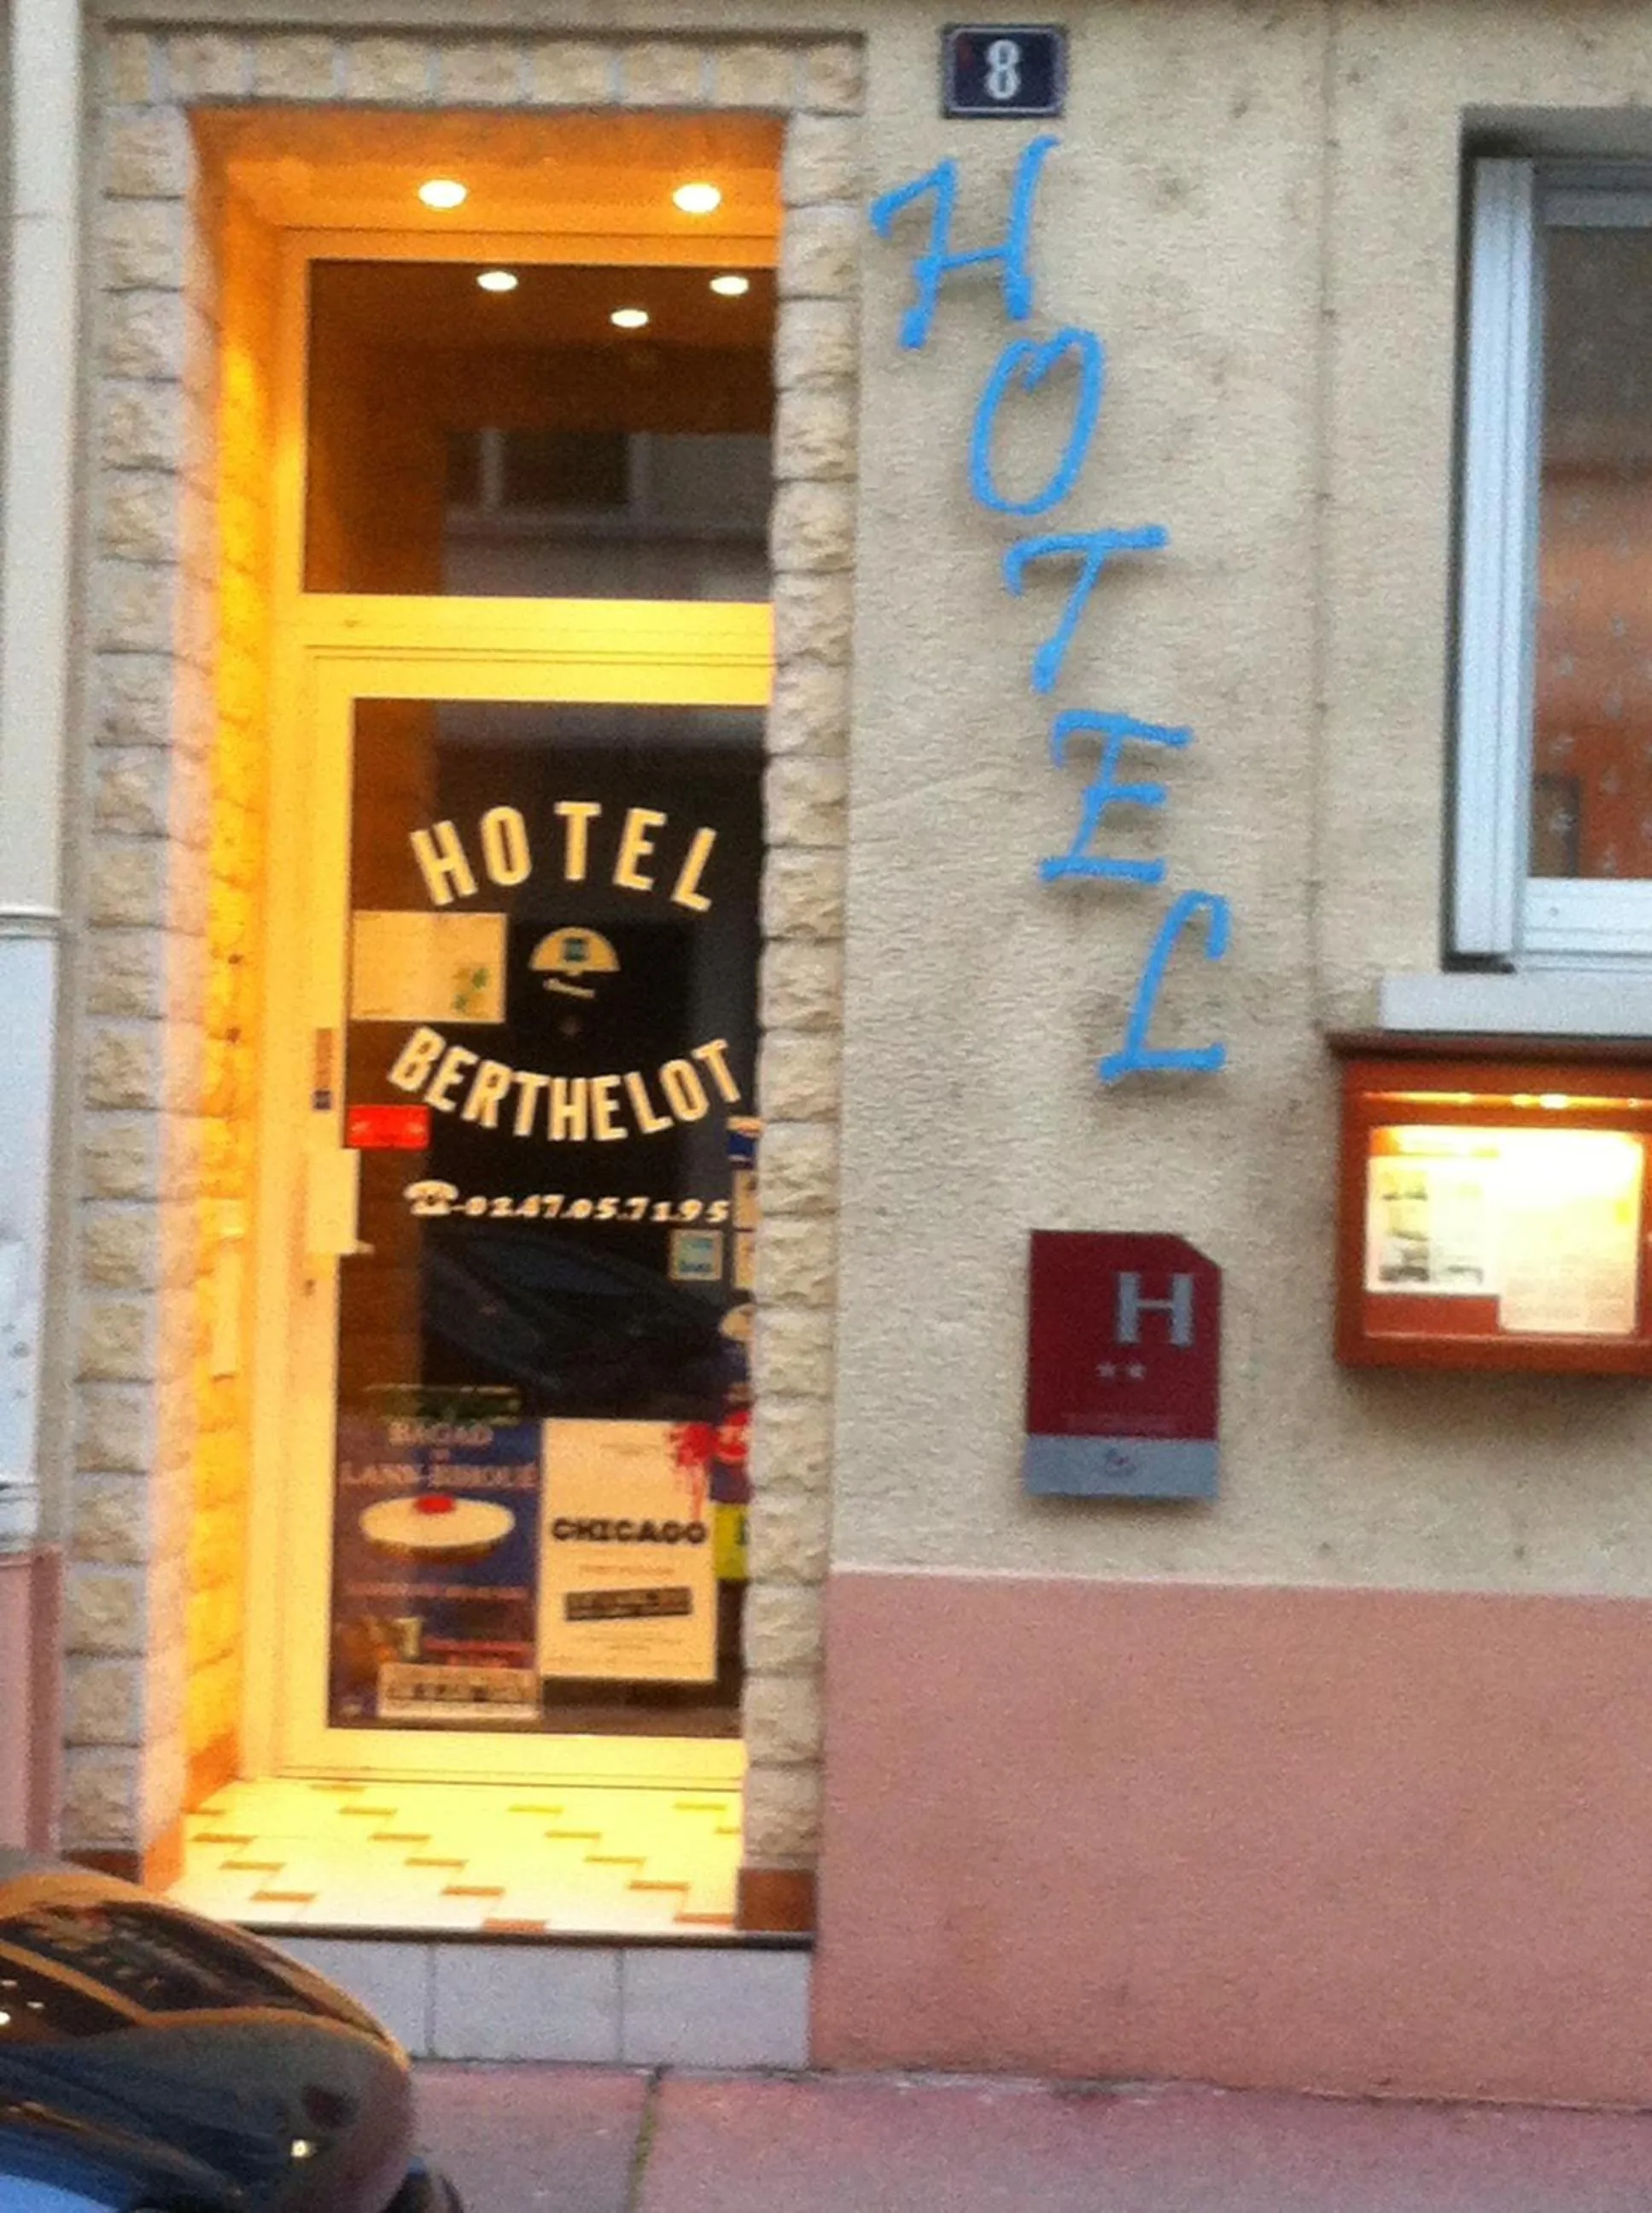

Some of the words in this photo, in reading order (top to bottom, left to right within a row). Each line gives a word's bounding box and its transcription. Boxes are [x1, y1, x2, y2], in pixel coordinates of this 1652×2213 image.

[983, 39, 1022, 100] 8
[869, 135, 1231, 1082] HOTEL
[410, 801, 717, 912] HOTEL
[387, 1026, 741, 1141] BERTHELOT
[1117, 1271, 1194, 1347] H
[552, 1517, 708, 1544] CHICAGO
